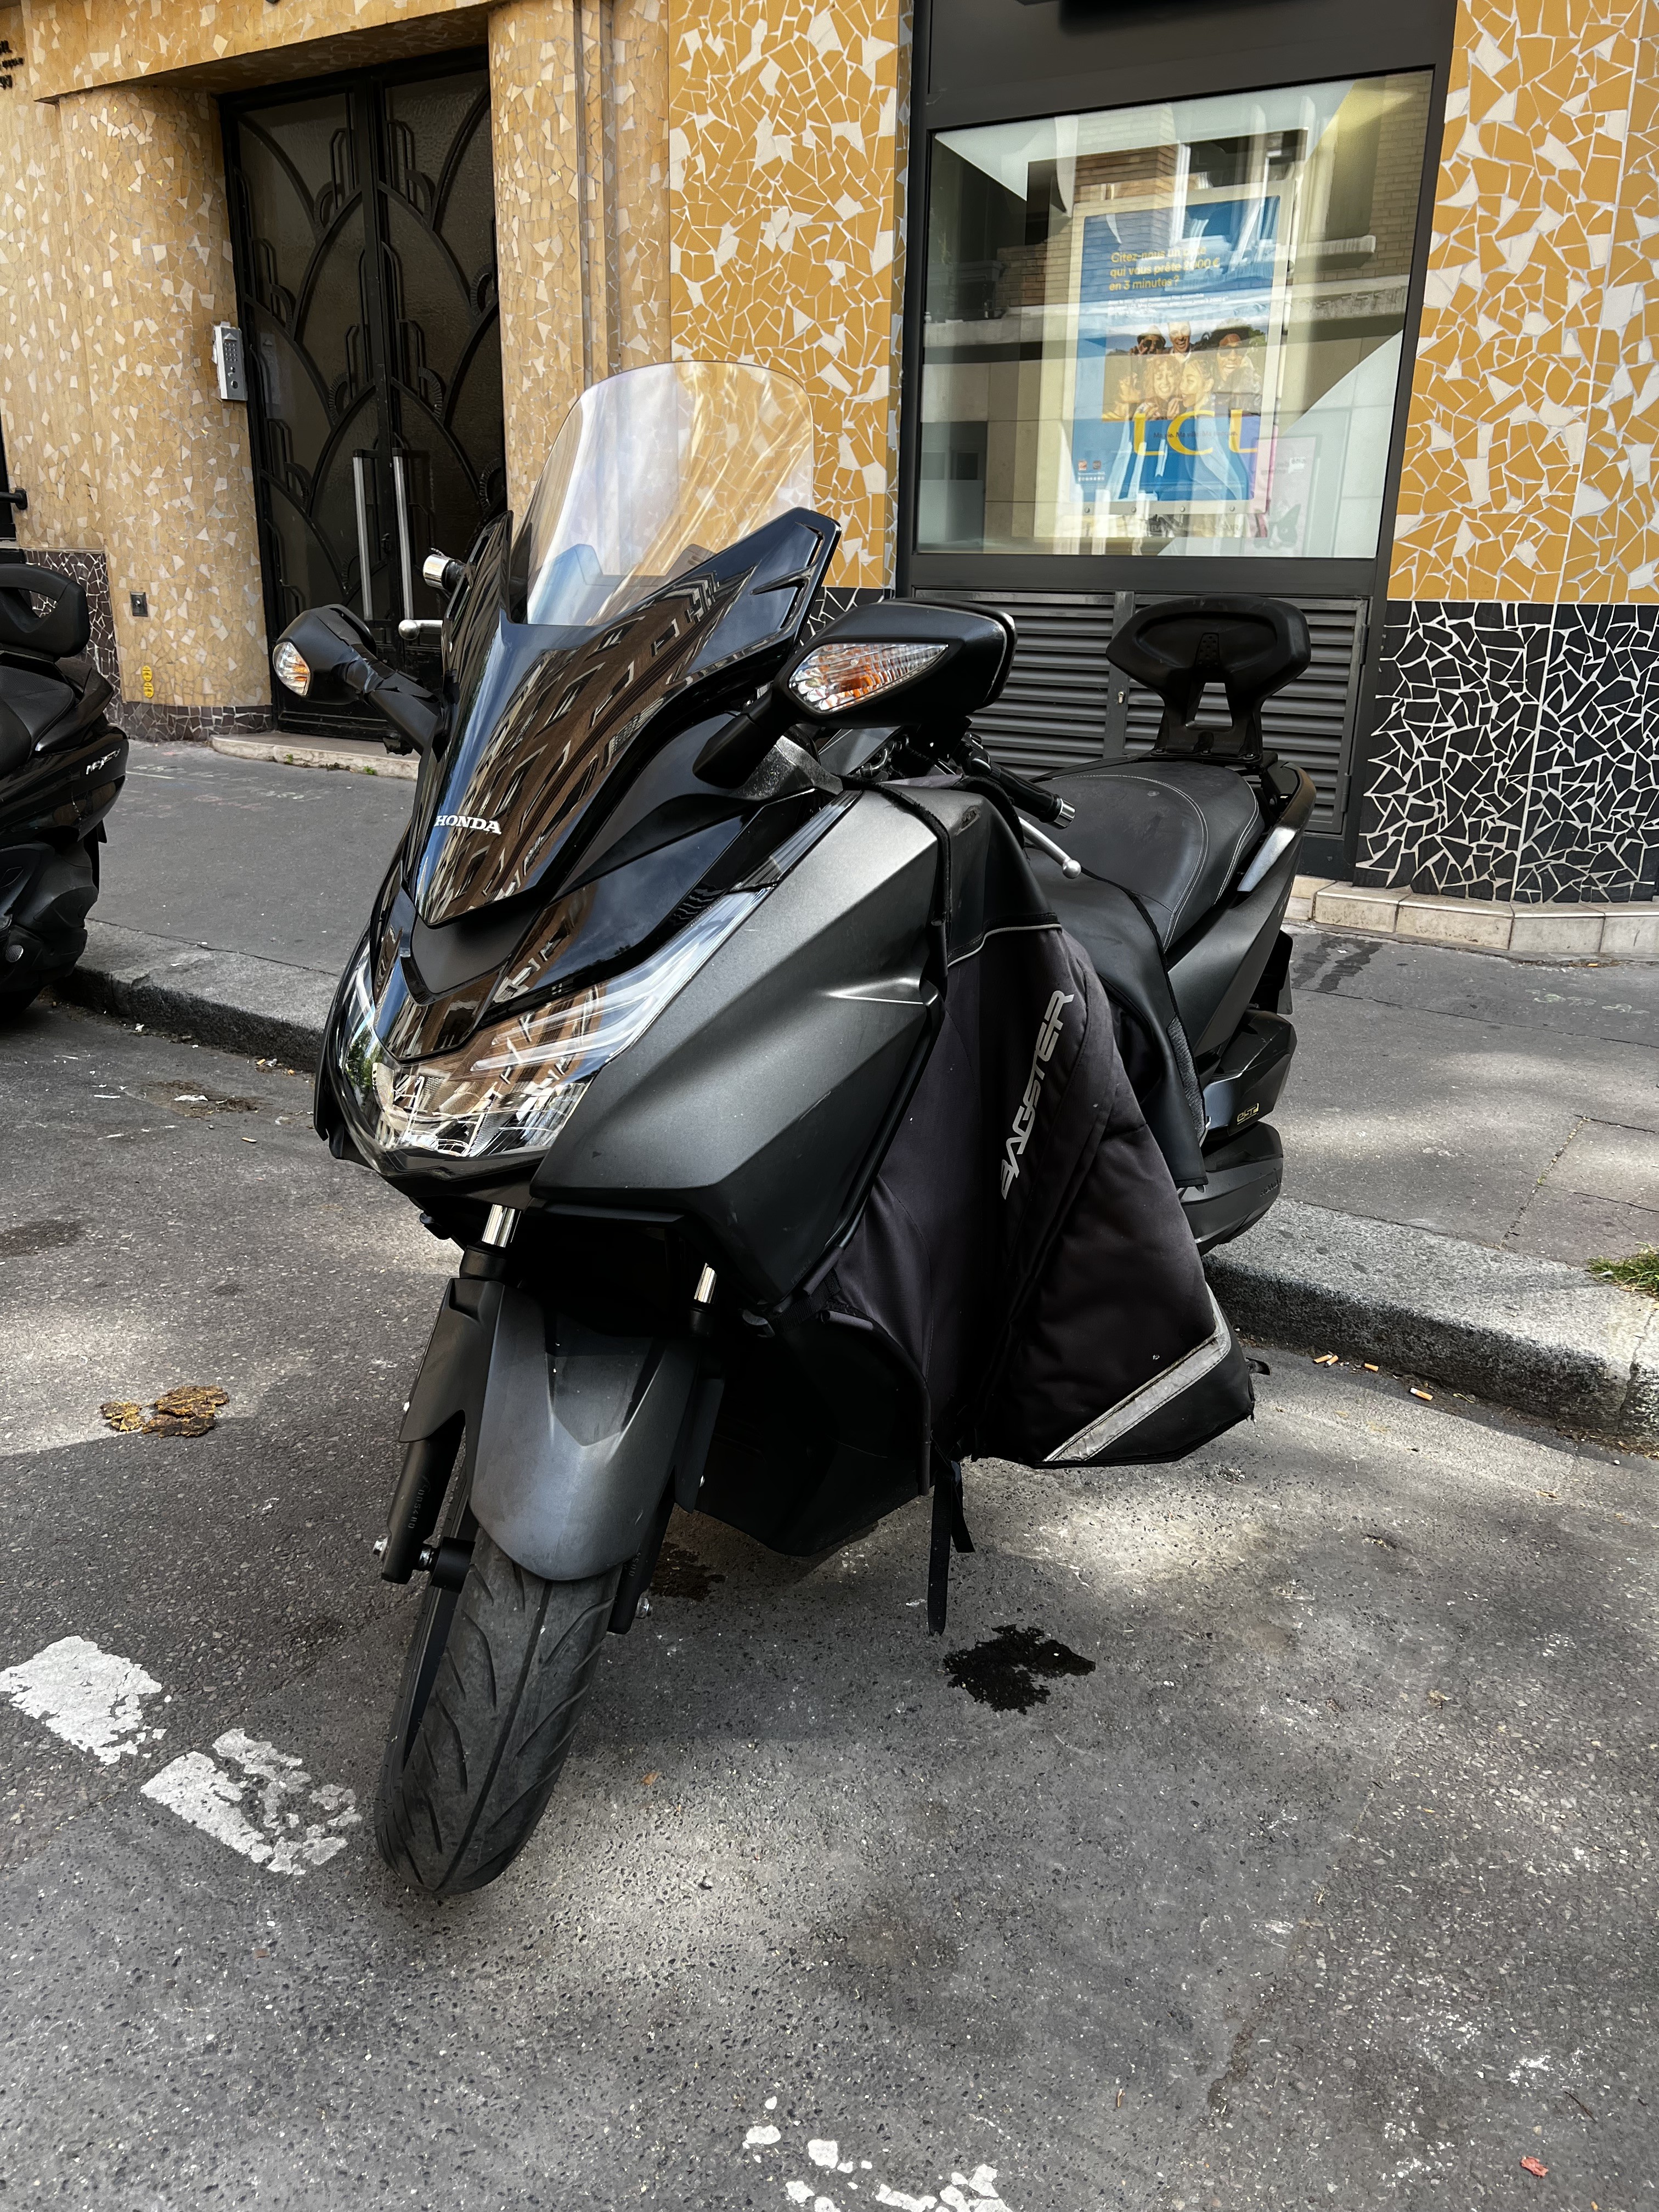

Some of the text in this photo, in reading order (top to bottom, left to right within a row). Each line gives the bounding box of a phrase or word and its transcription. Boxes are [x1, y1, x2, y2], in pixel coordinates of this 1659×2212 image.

[1110, 250, 1165, 263] Citez-nous
[1110, 264, 1126, 279] qui
[1128, 265, 1152, 275] vous
[1154, 262, 1181, 276] prête
[1109, 282, 1121, 291] en
[1124, 280, 1130, 290] 3
[1133, 409, 1258, 456] LCL
[434, 815, 503, 835] HONDA
[1000, 990, 1075, 1200] BAGSTER
